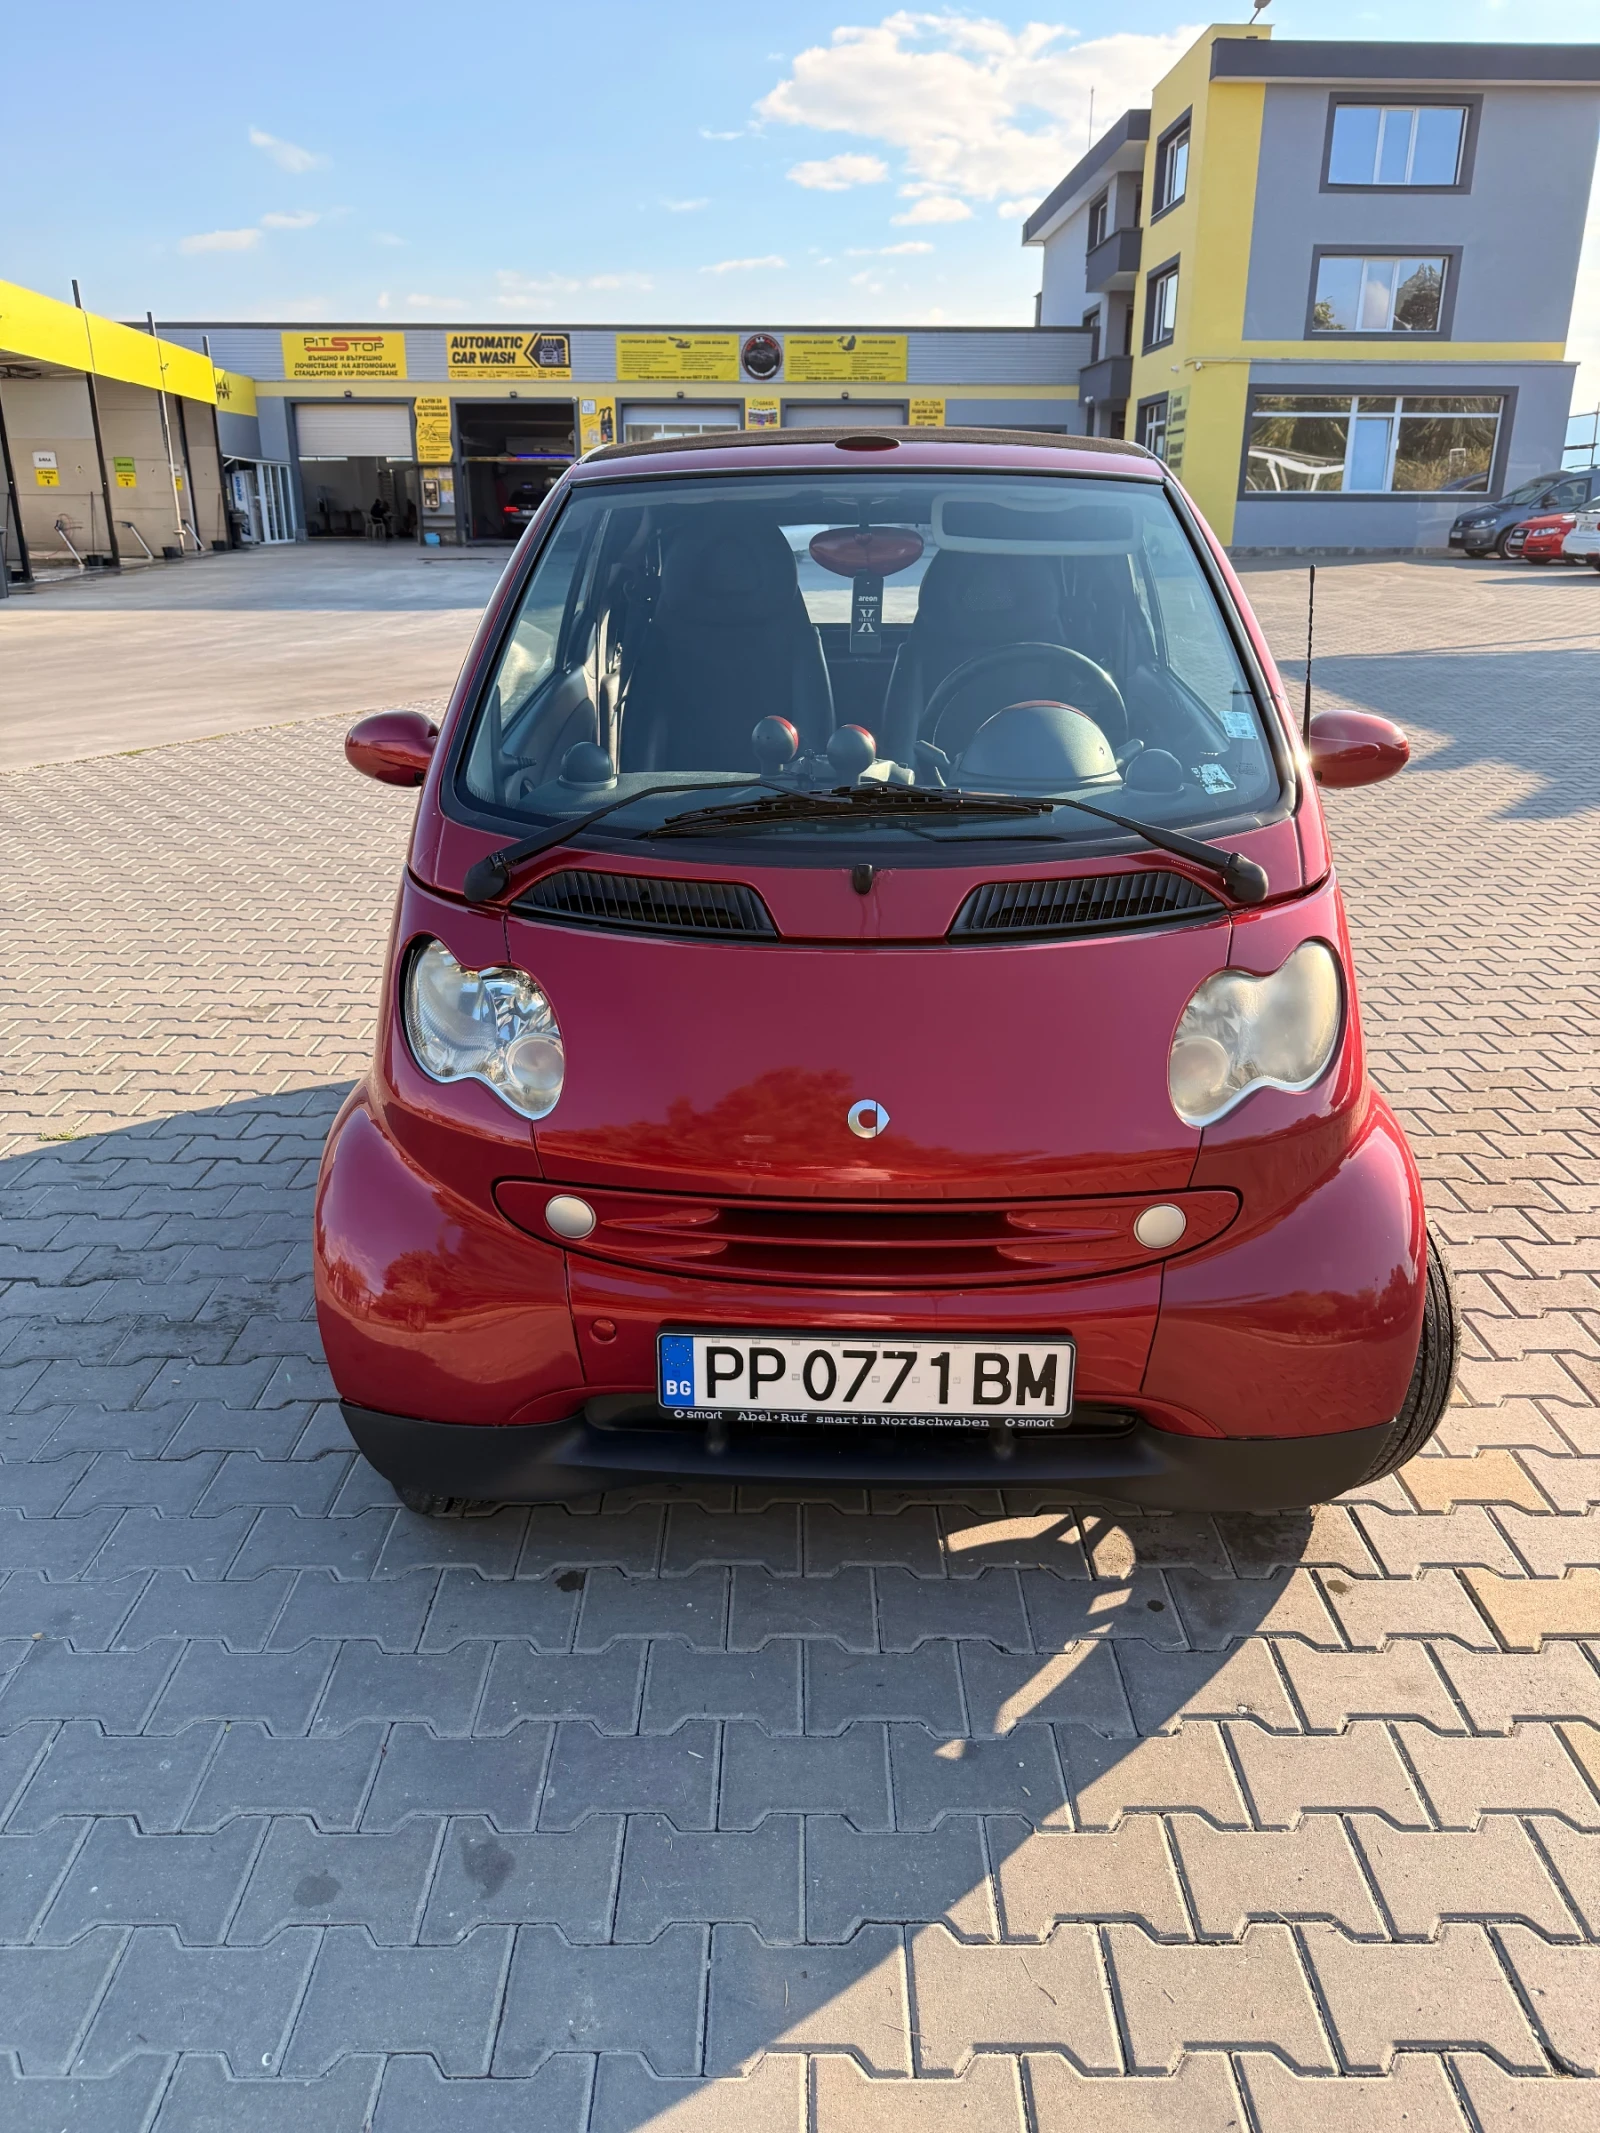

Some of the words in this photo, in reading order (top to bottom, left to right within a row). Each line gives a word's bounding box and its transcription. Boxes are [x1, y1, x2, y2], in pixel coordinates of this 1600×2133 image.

[451, 336, 524, 349] AUTOMATIC
[452, 351, 476, 364] CAR
[479, 351, 516, 364] WASH
[706, 1346, 786, 1400] PP
[803, 1349, 950, 1405] 0771
[973, 1352, 1058, 1406] BM
[666, 1380, 692, 1396] BG
[686, 1411, 722, 1420] smart
[737, 1411, 808, 1423] Abel+Ruf
[816, 1415, 859, 1424] smart
[862, 1415, 877, 1425] in
[880, 1416, 990, 1427] Nordschwaben
[1017, 1418, 1055, 1427] smart
